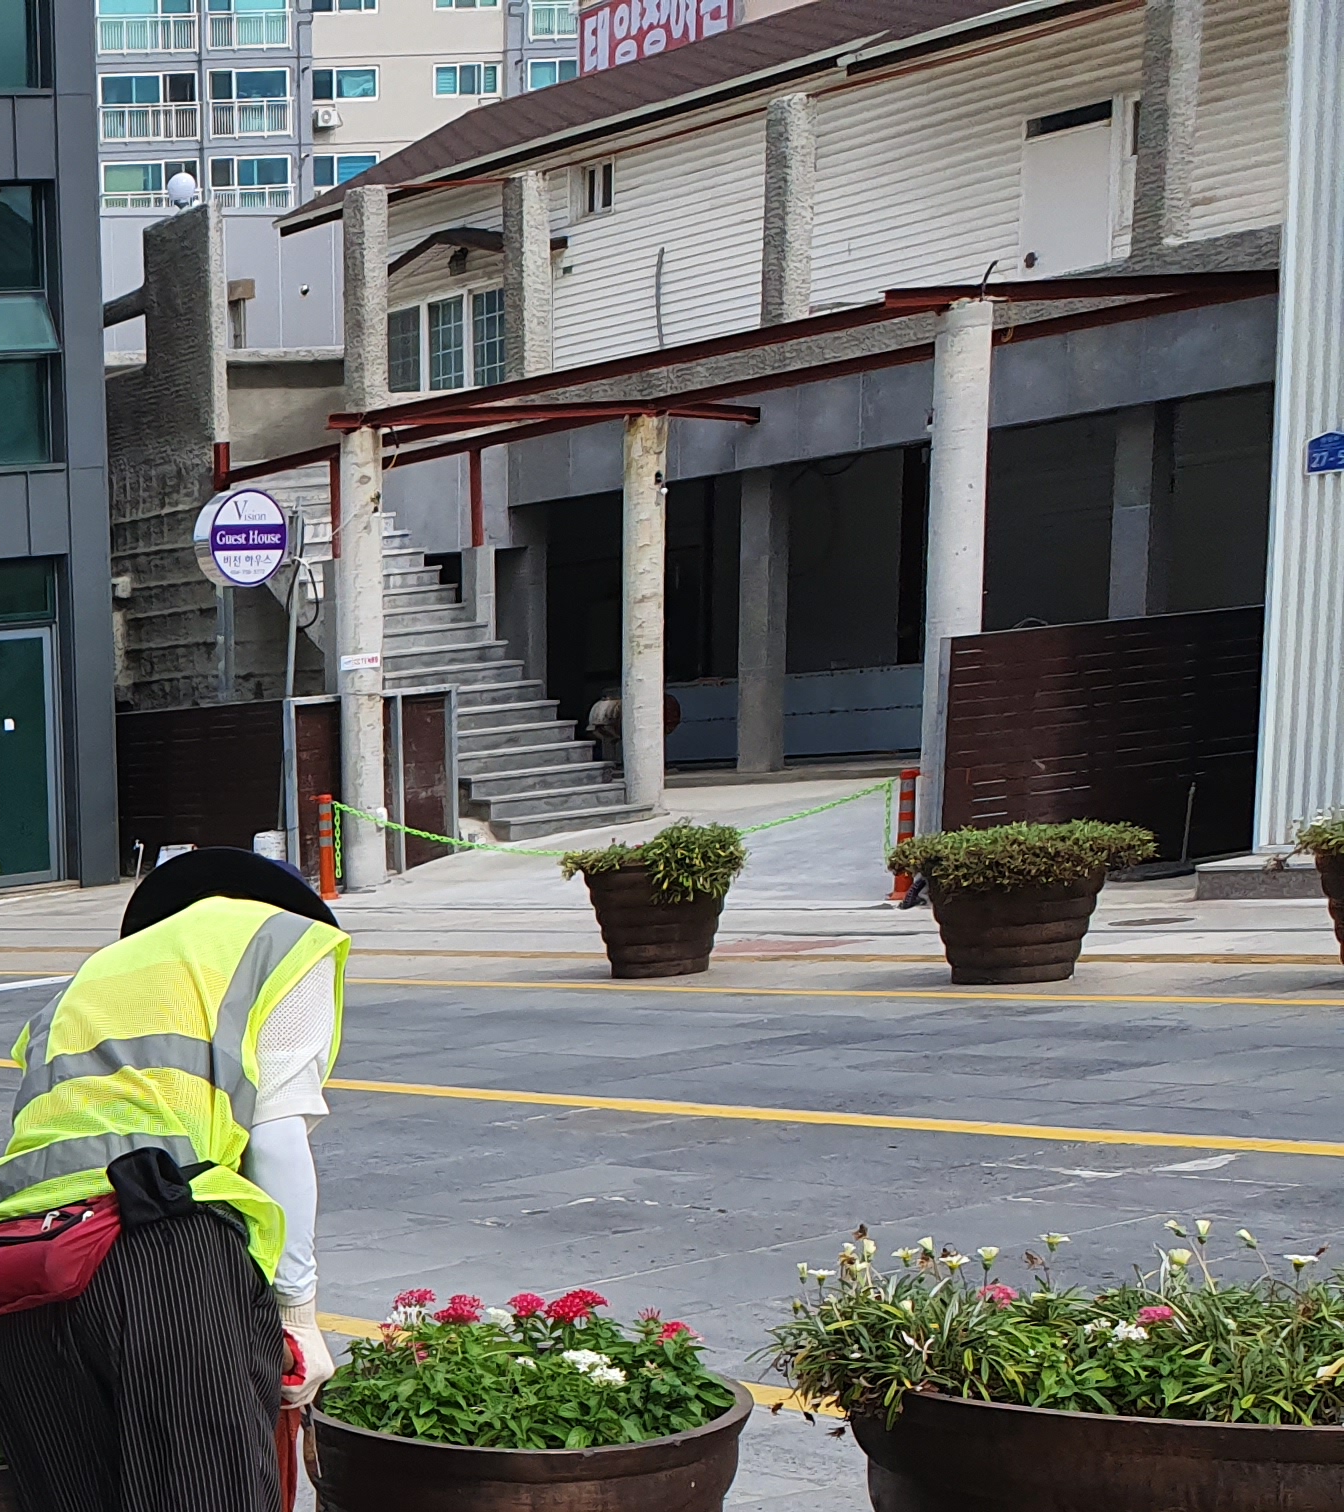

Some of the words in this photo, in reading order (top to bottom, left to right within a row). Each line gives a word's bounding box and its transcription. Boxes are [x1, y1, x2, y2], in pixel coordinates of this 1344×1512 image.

[233, 499, 266, 521] Vision
[216, 530, 247, 545] Guest
[249, 529, 282, 545] House
[223, 555, 242, 568] 비전
[244, 554, 273, 567] 하우스
